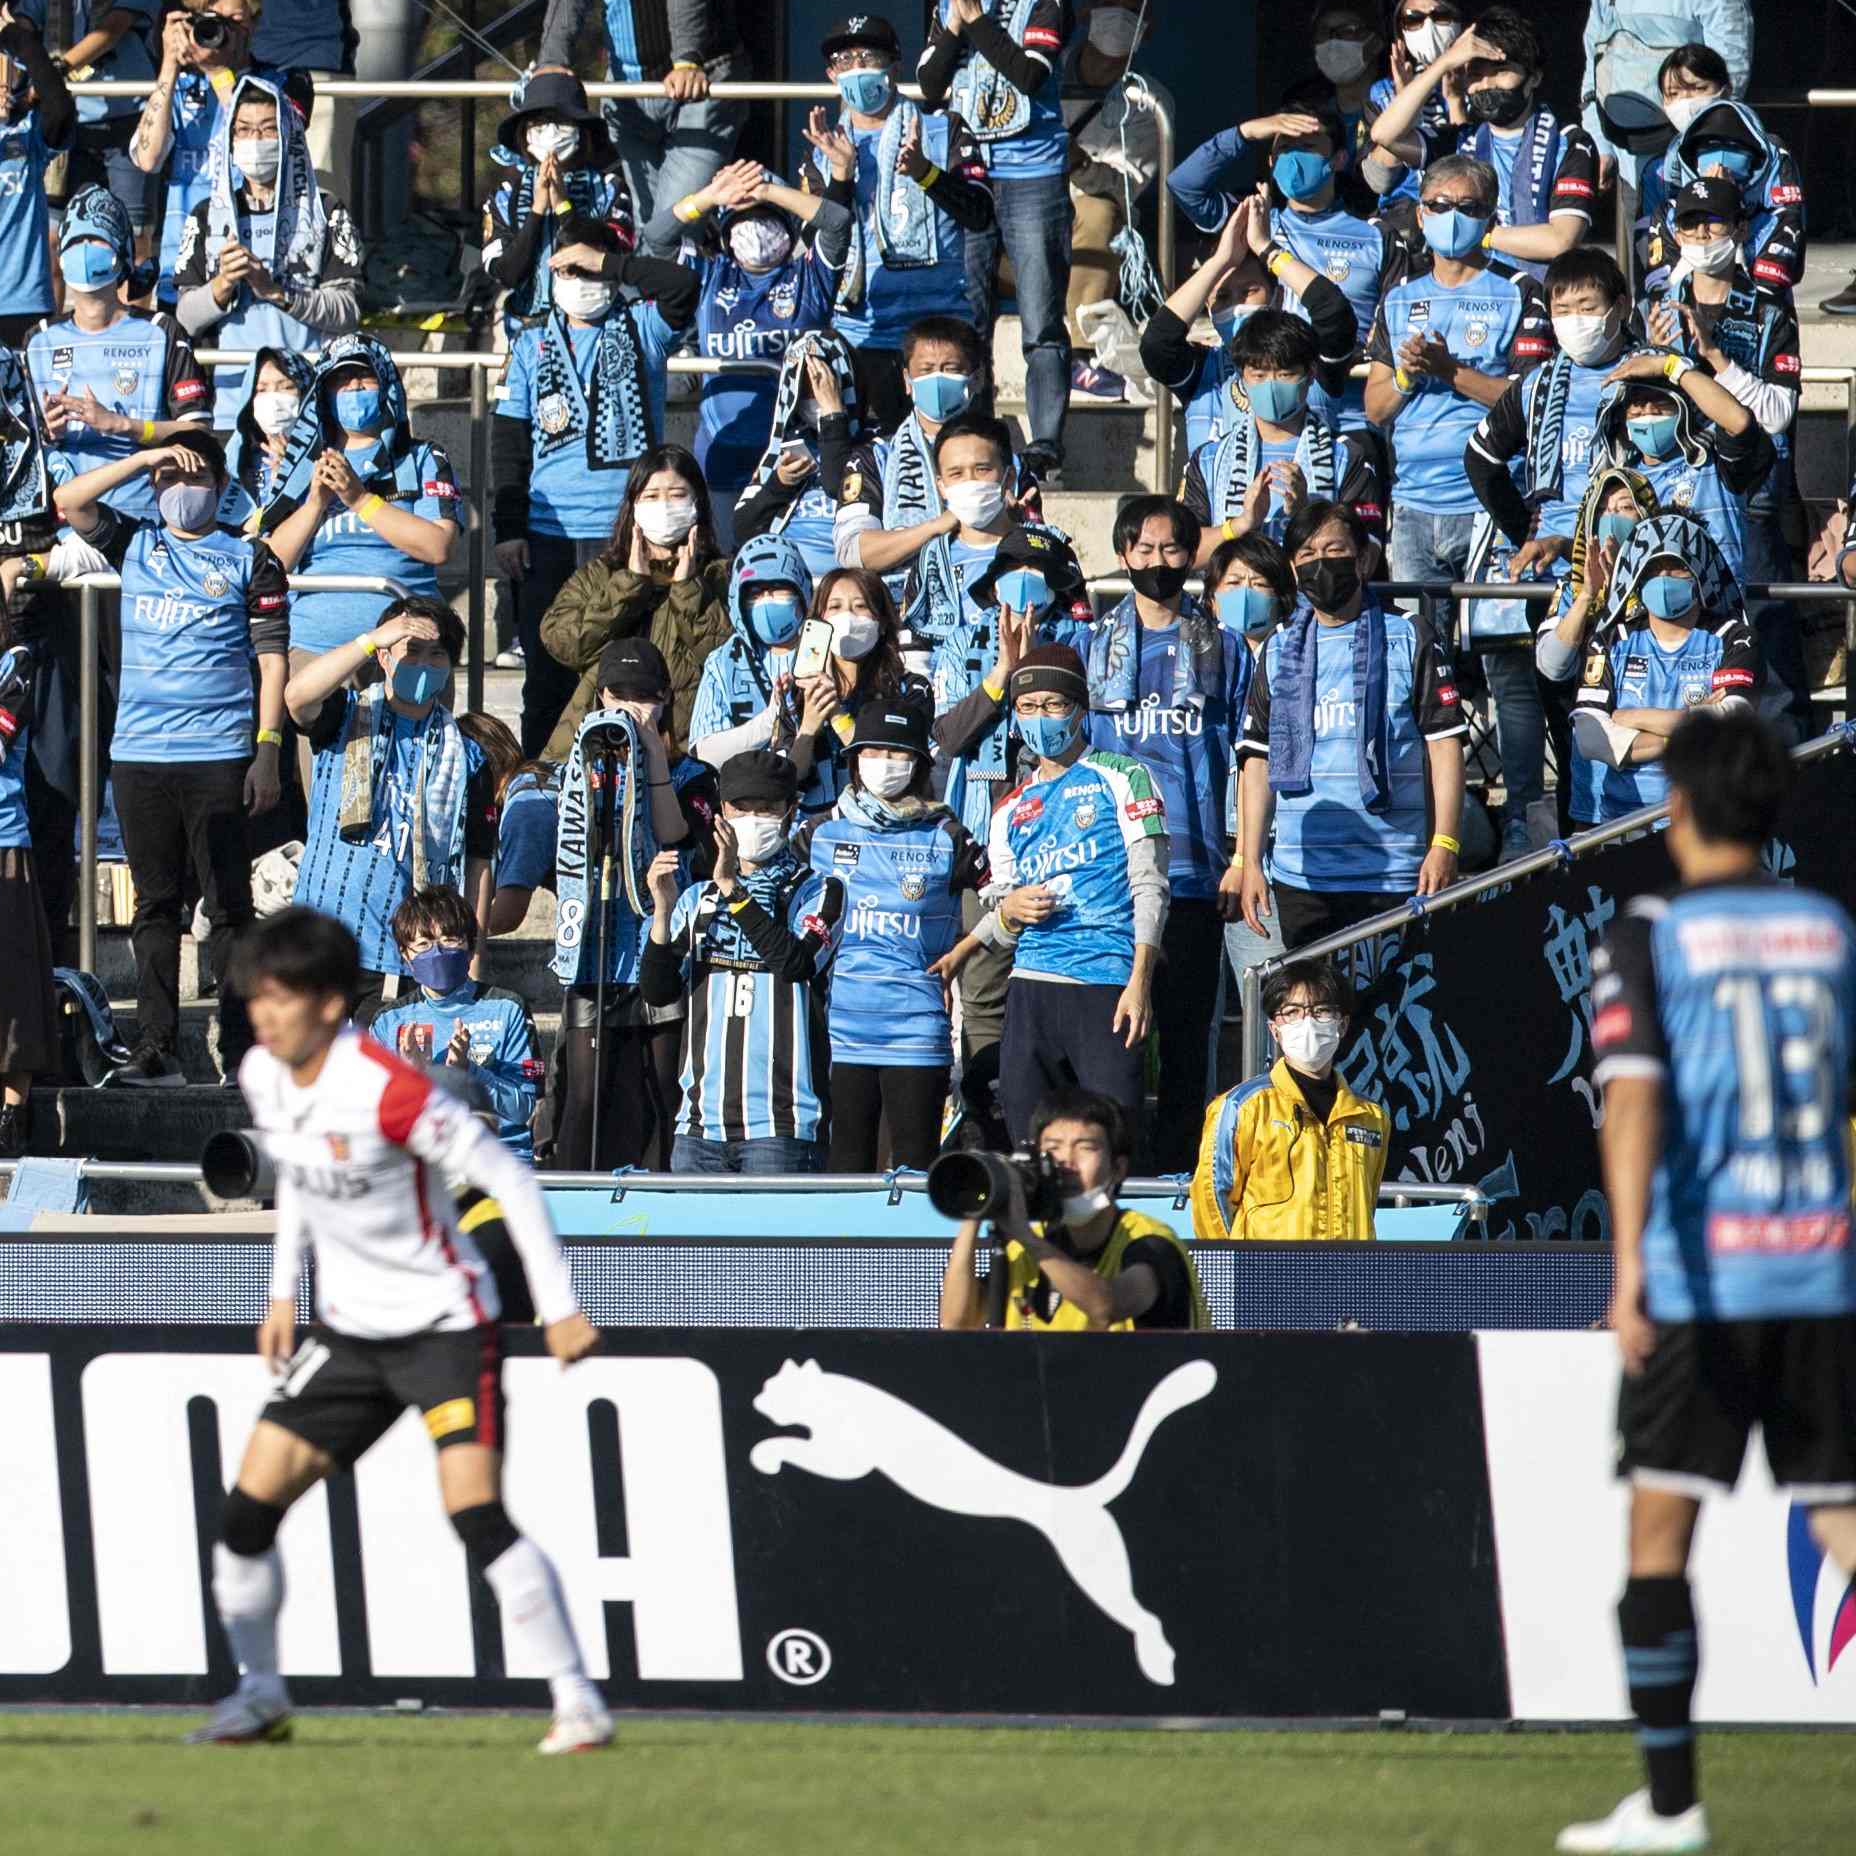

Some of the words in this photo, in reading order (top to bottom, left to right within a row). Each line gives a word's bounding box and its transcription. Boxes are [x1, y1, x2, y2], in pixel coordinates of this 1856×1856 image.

[890, 189, 910, 234] 5
[1318, 239, 1368, 252] RENOSY
[1457, 300, 1505, 314] RENOSY
[103, 346, 152, 359] RENOSY
[192, 551, 241, 568] RENOSY
[133, 594, 220, 628] FUJITSU
[1064, 785, 1110, 805] RENOSY
[371, 819, 409, 865] 41
[890, 850, 942, 863] RENOSY
[557, 897, 584, 950] 8
[842, 906, 922, 941] UJITSU
[724, 972, 755, 1018] 16
[1711, 976, 1840, 1143] 13
